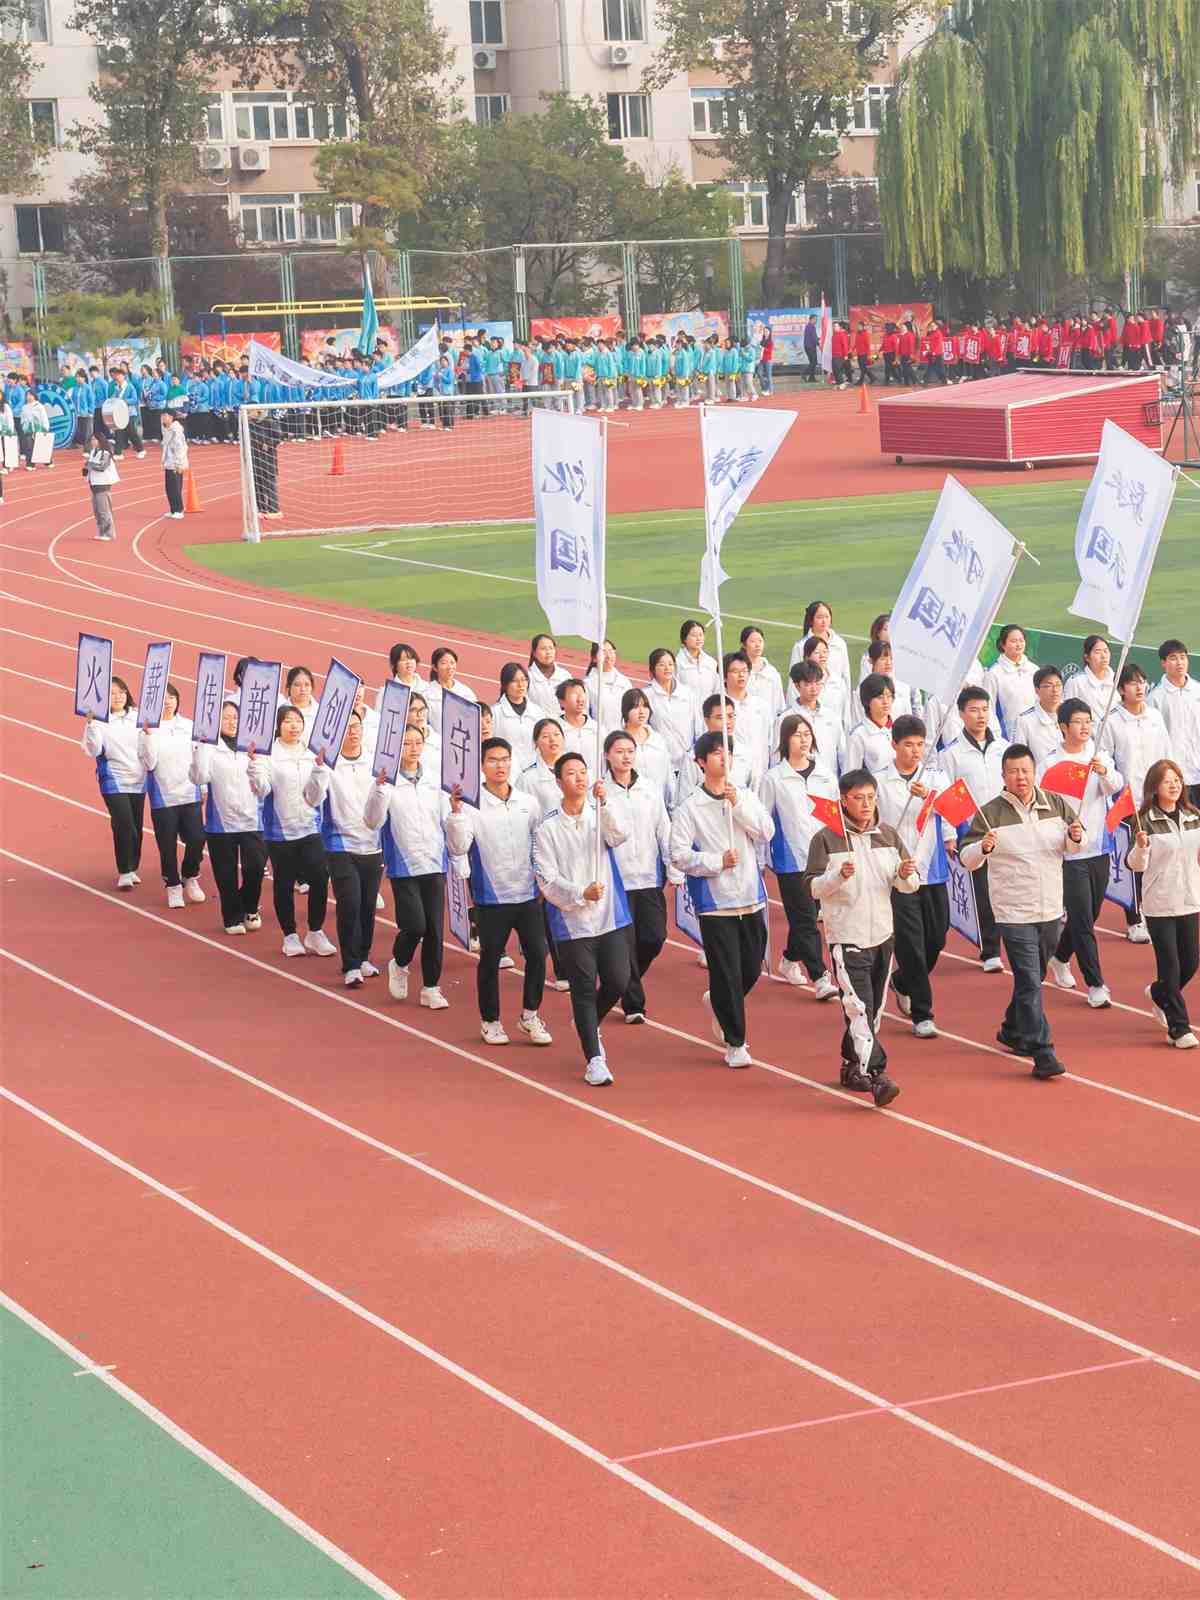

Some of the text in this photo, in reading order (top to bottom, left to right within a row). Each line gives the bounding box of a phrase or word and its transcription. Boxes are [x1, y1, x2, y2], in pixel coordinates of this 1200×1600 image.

[84, 656, 102, 703] 火
[146, 661, 164, 711] 薪
[202, 673, 217, 725] 传
[247, 680, 270, 736] 新
[323, 688, 348, 745] 创
[381, 708, 400, 758] 正
[450, 719, 471, 780] 守
